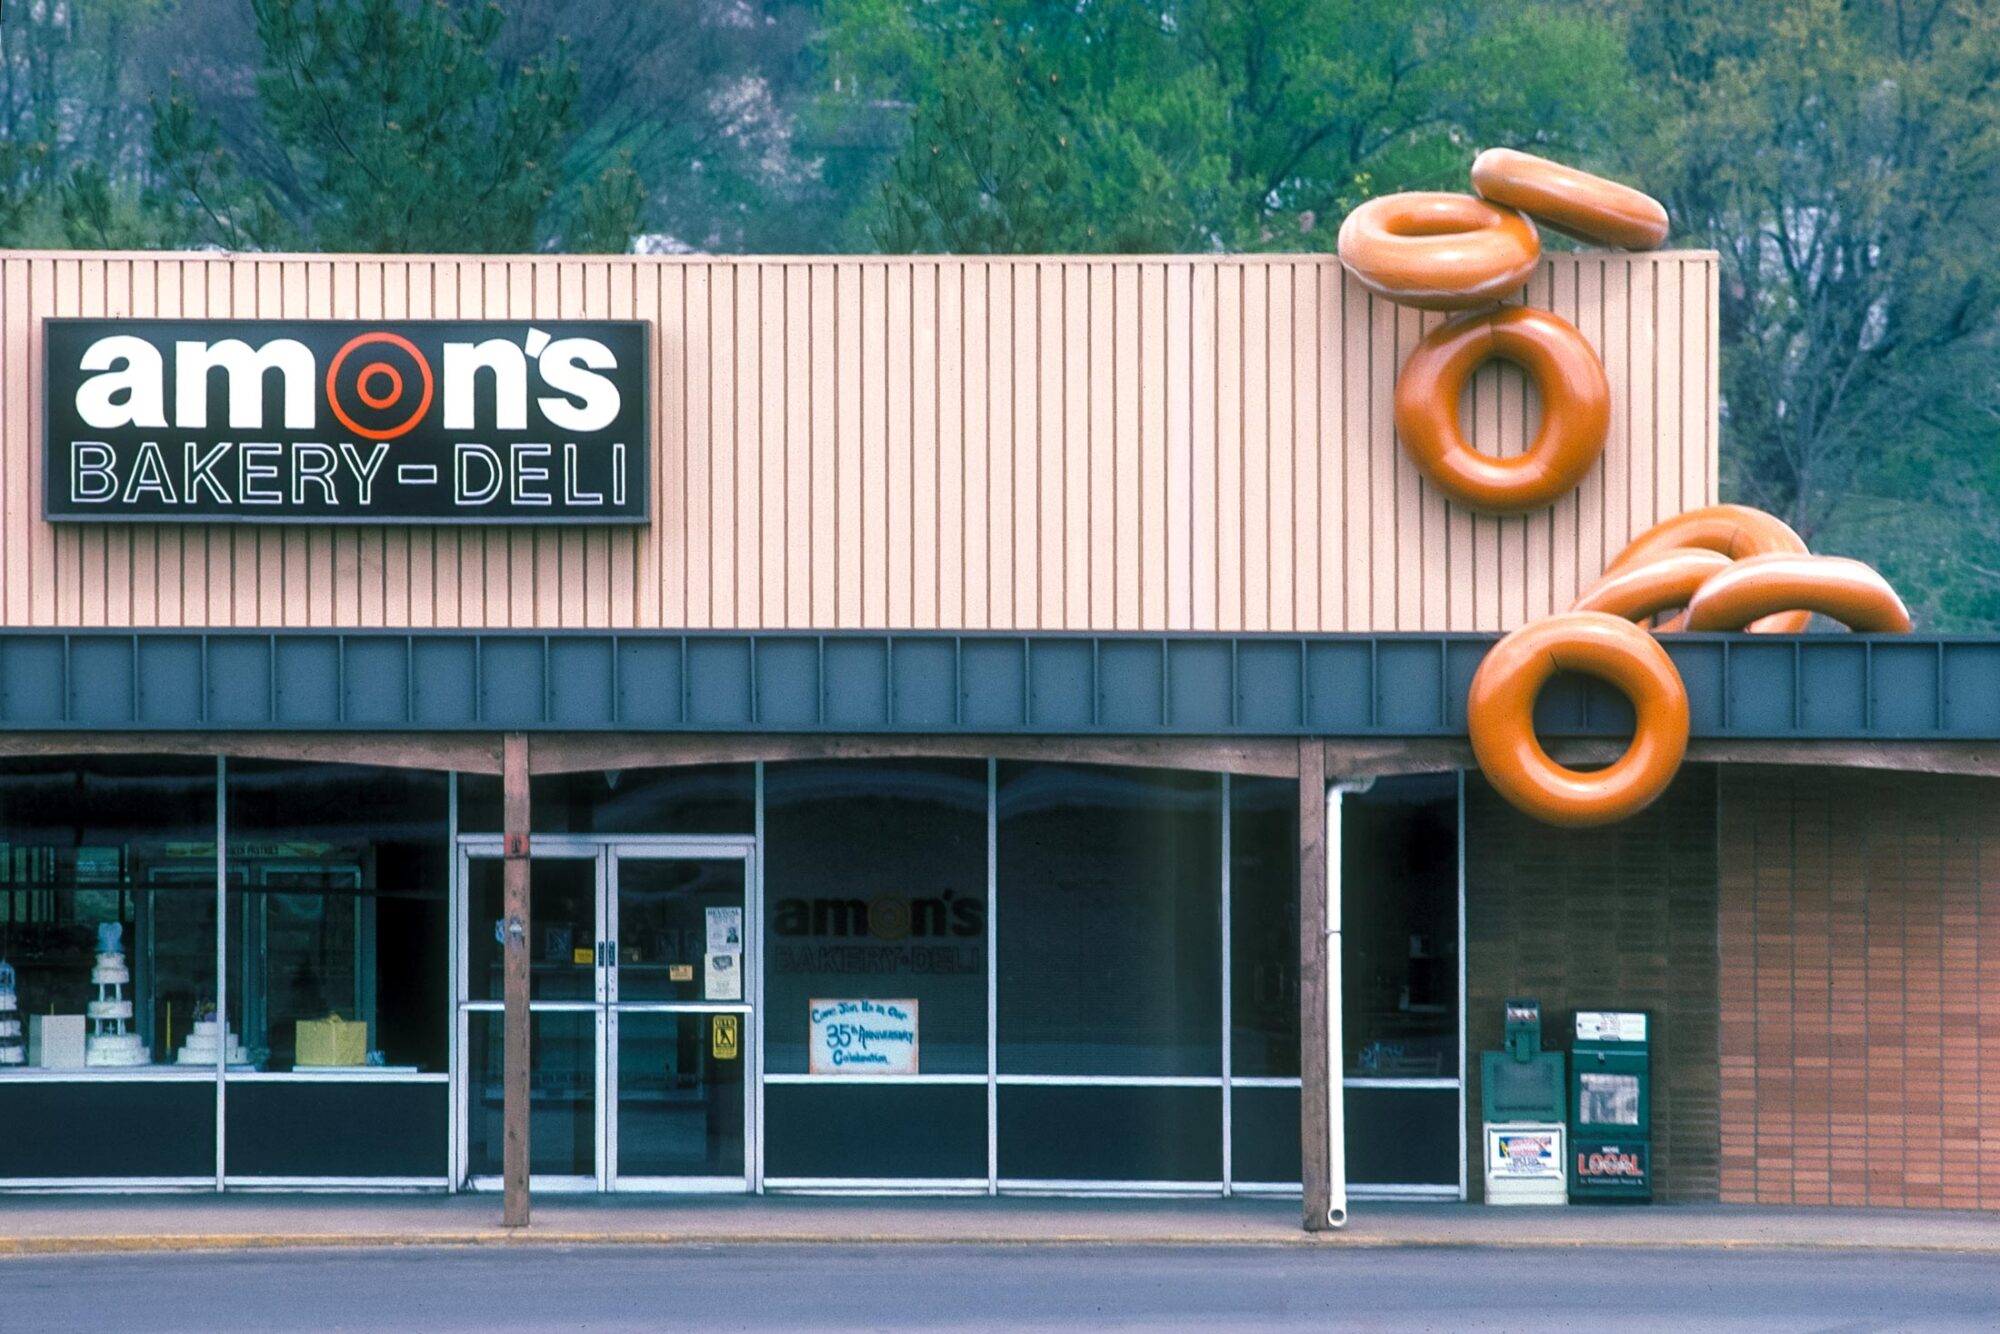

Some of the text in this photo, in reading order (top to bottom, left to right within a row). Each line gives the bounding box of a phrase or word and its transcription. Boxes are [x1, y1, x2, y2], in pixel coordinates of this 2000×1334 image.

[75, 327, 621, 440] amon's
[773, 888, 984, 940] amon's
[1578, 1152, 1644, 1176] LOCAL
